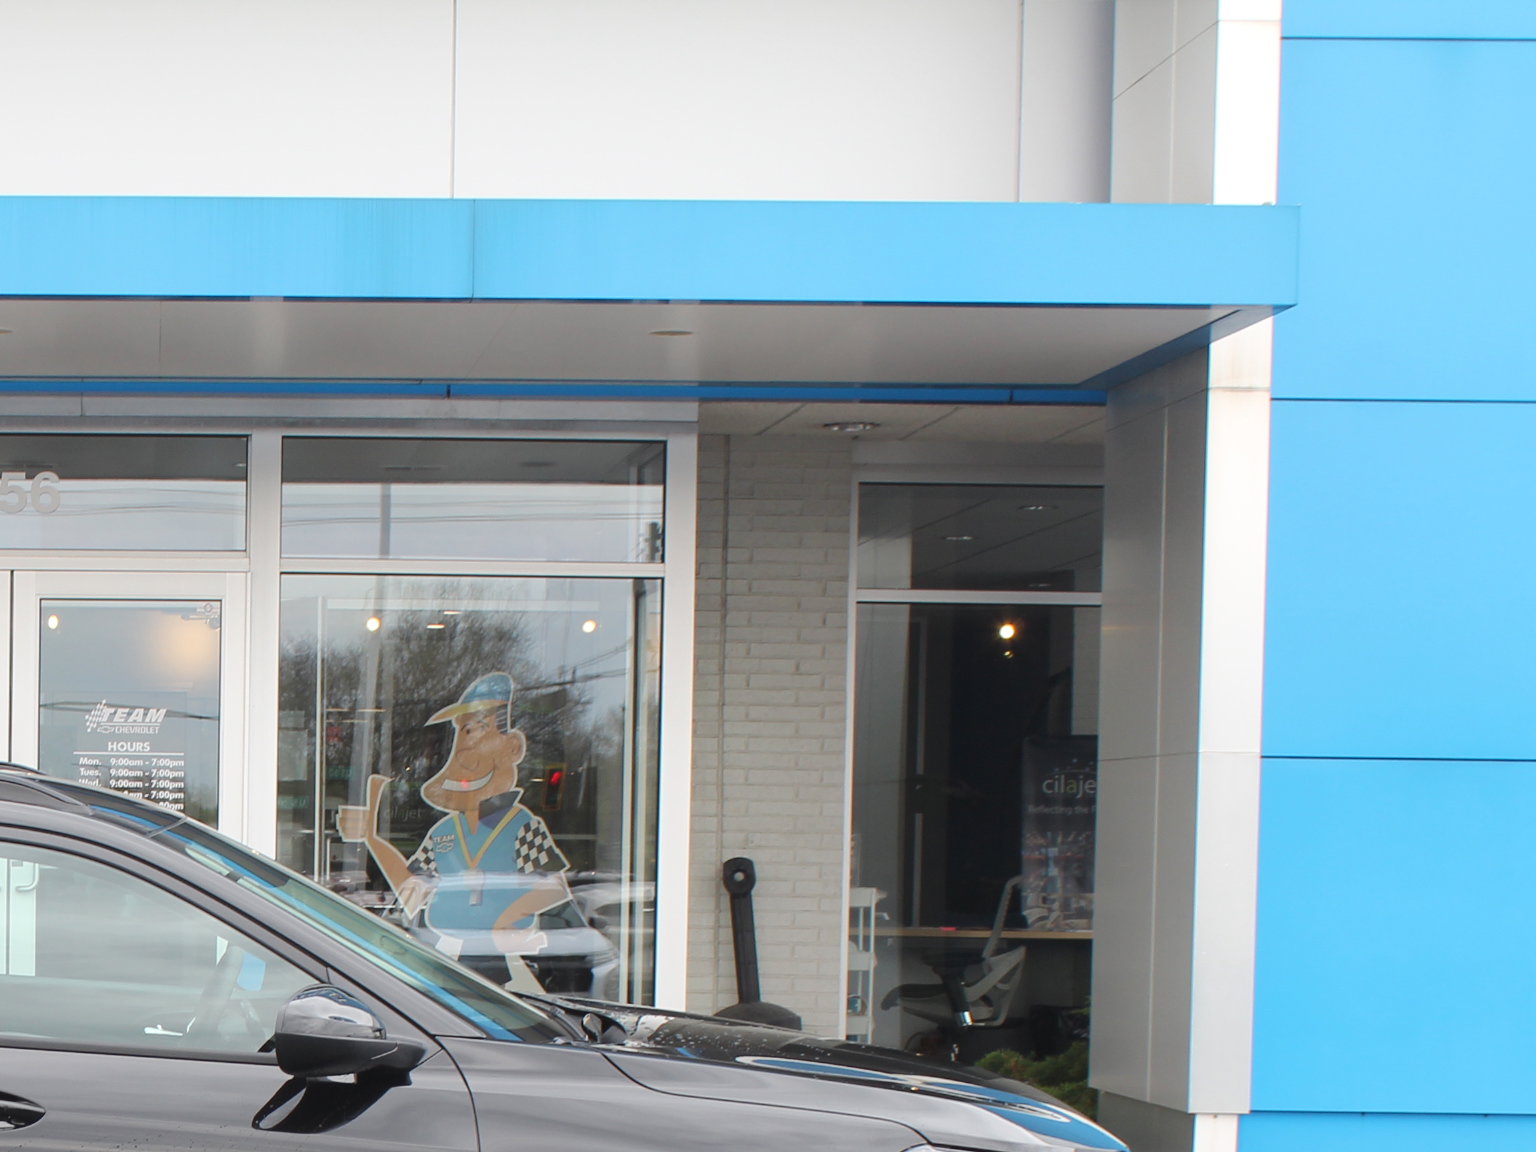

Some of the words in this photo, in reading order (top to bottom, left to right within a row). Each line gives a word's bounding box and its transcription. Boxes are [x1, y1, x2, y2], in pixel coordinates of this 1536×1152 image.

[101, 708, 167, 723] TEAM
[115, 726, 160, 735] CHEVROLET
[107, 741, 151, 752] HOURS
[79, 757, 102, 766] Mon.
[110, 757, 143, 767] 9:00am
[151, 758, 184, 768] 7:00pm
[80, 767, 102, 777] Tues.
[110, 768, 143, 778] 9:00am
[151, 769, 184, 779] 7:00pm
[109, 779, 143, 788] 9:00am
[151, 780, 184, 790] 7:00pm
[1042, 774, 1097, 798] cilaje
[150, 790, 184, 801] 7:00pm
[433, 834, 455, 843] TEAM
